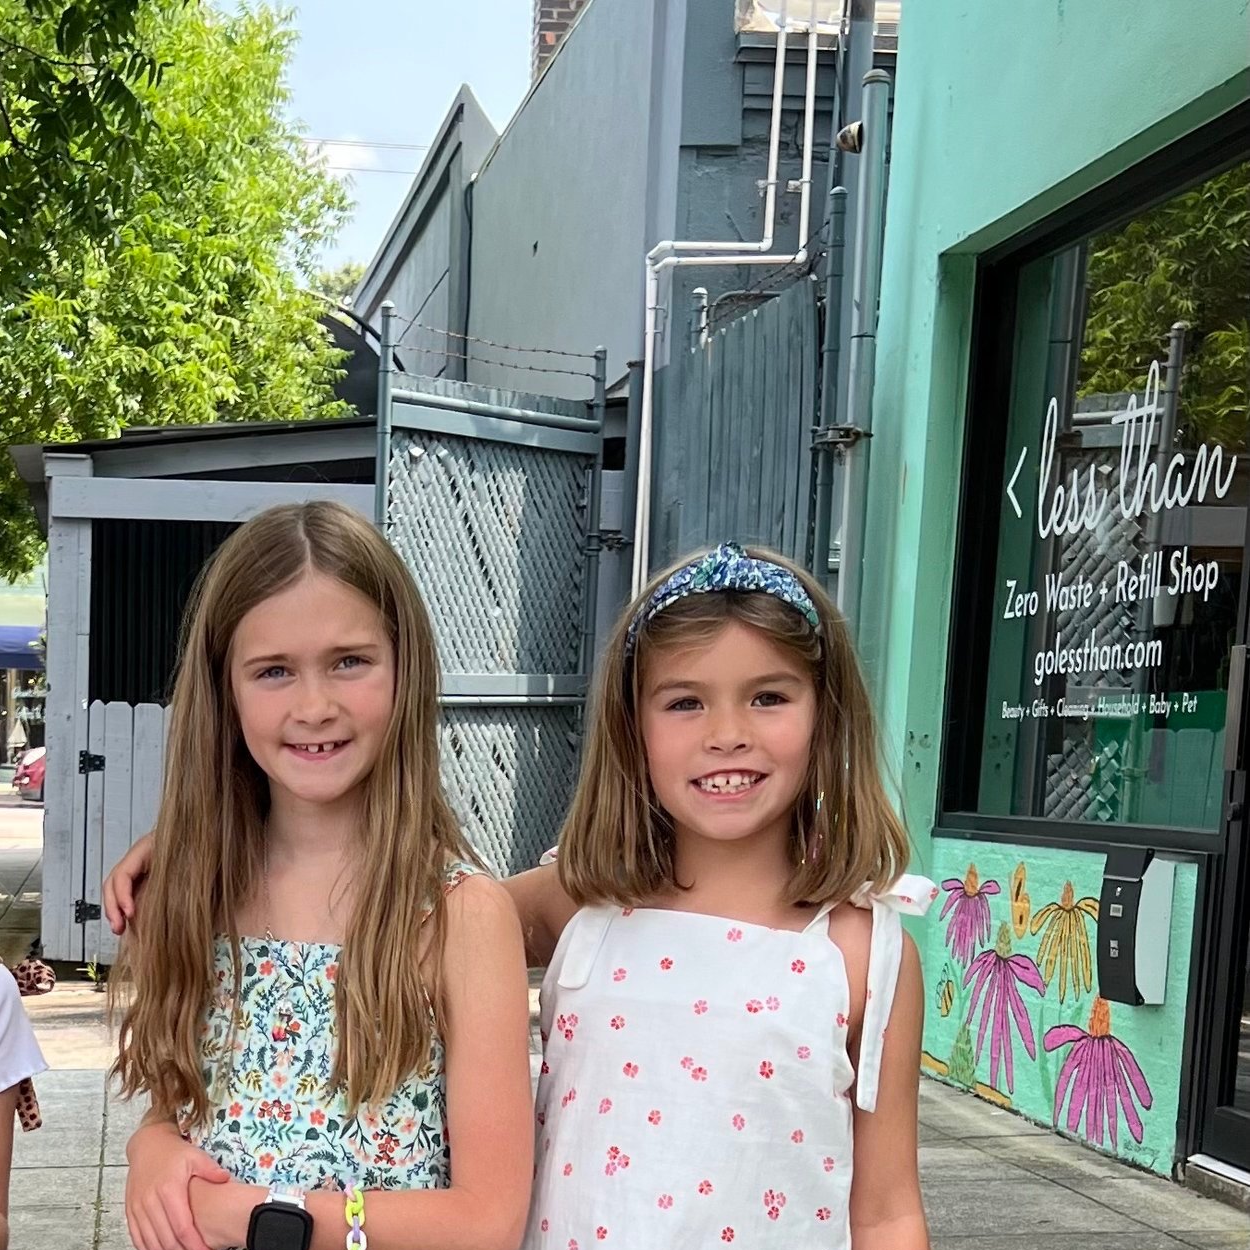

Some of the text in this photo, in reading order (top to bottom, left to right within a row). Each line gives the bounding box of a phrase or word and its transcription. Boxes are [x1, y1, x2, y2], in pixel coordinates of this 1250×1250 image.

[1038, 396, 1109, 540] less
[1111, 359, 1238, 520] than
[1003, 579, 1039, 620] Zero
[1046, 571, 1094, 615] Waste
[1115, 550, 1163, 604] Refill
[1168, 546, 1220, 603] Shop
[1033, 627, 1163, 687] golessthan.com
[1001, 701, 1025, 721] Beauty
[1031, 698, 1049, 718] Gifts
[1057, 698, 1089, 721] Cleaning
[1097, 693, 1140, 714] Household
[1149, 692, 1172, 719] Baby
[1182, 692, 1198, 714] Pet
